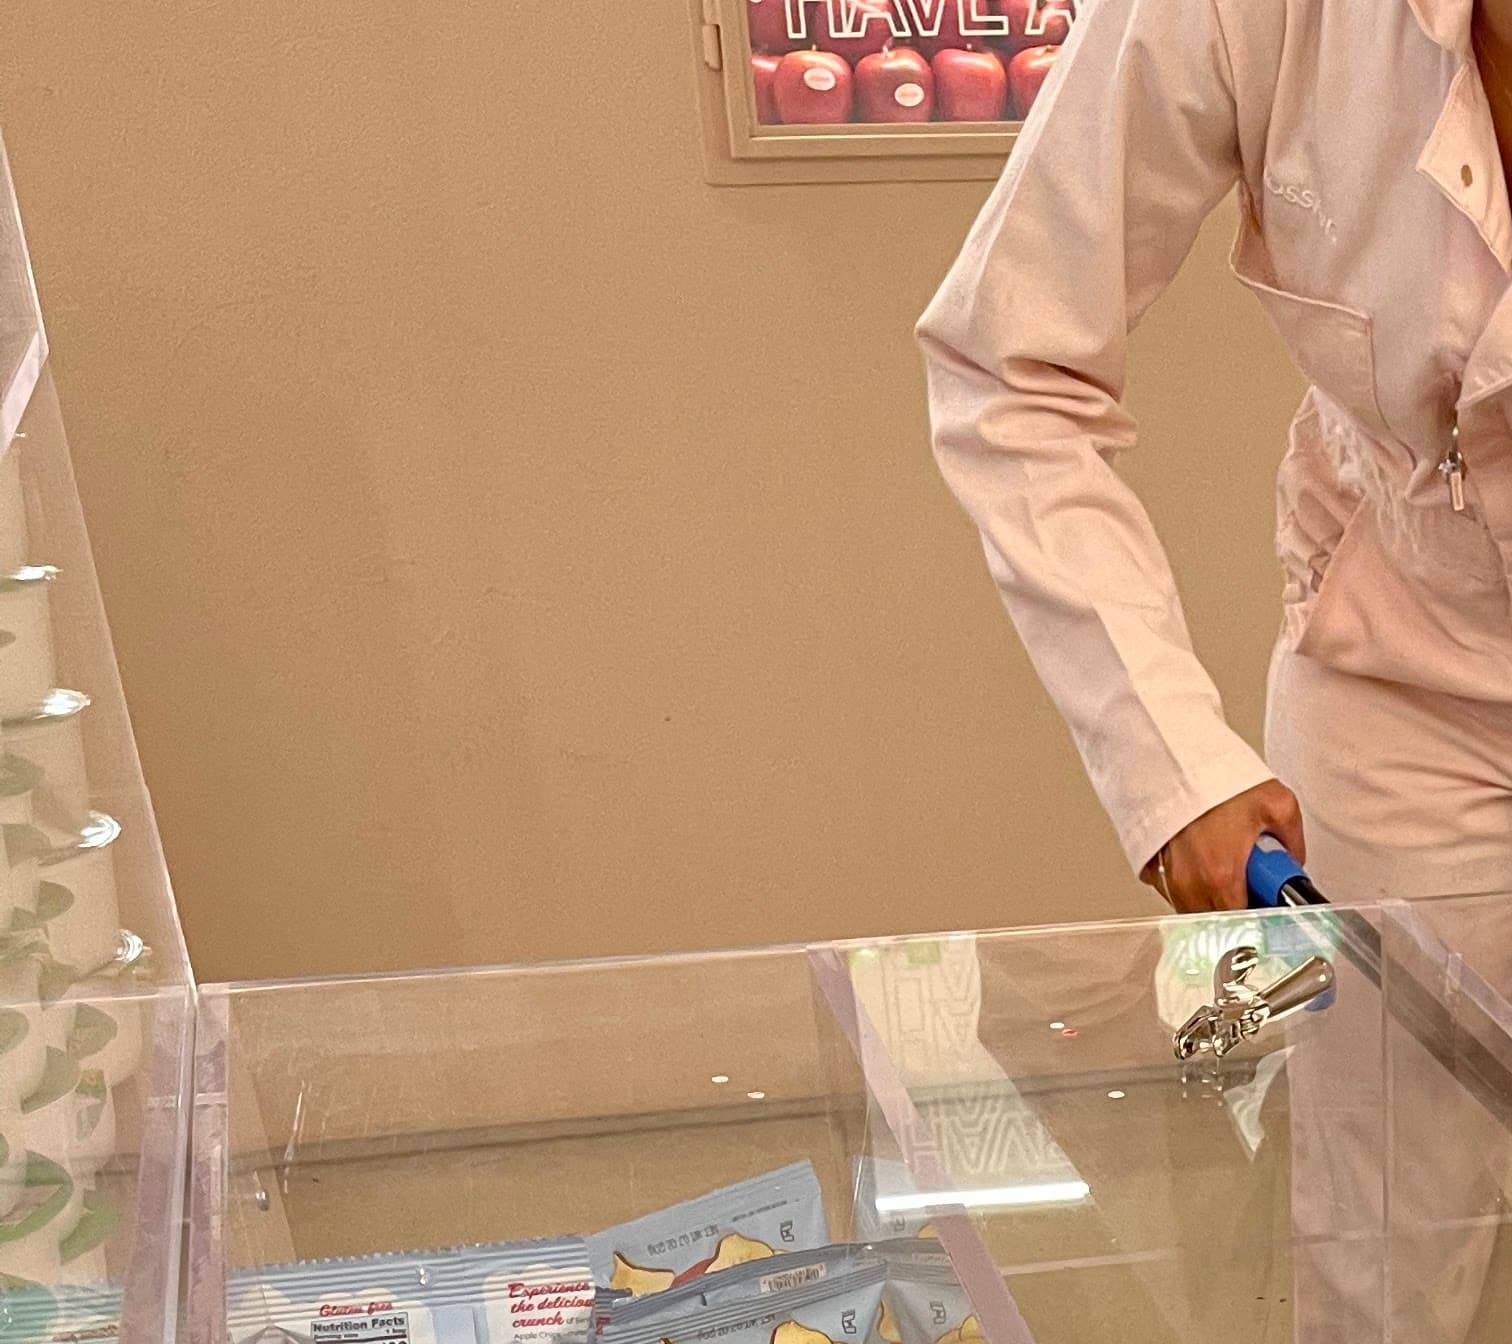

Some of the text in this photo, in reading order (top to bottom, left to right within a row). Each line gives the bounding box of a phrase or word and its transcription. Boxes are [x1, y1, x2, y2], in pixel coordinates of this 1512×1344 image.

[313, 1315, 405, 1333] Nutrition Facts
[512, 1311, 565, 1329] crunch
